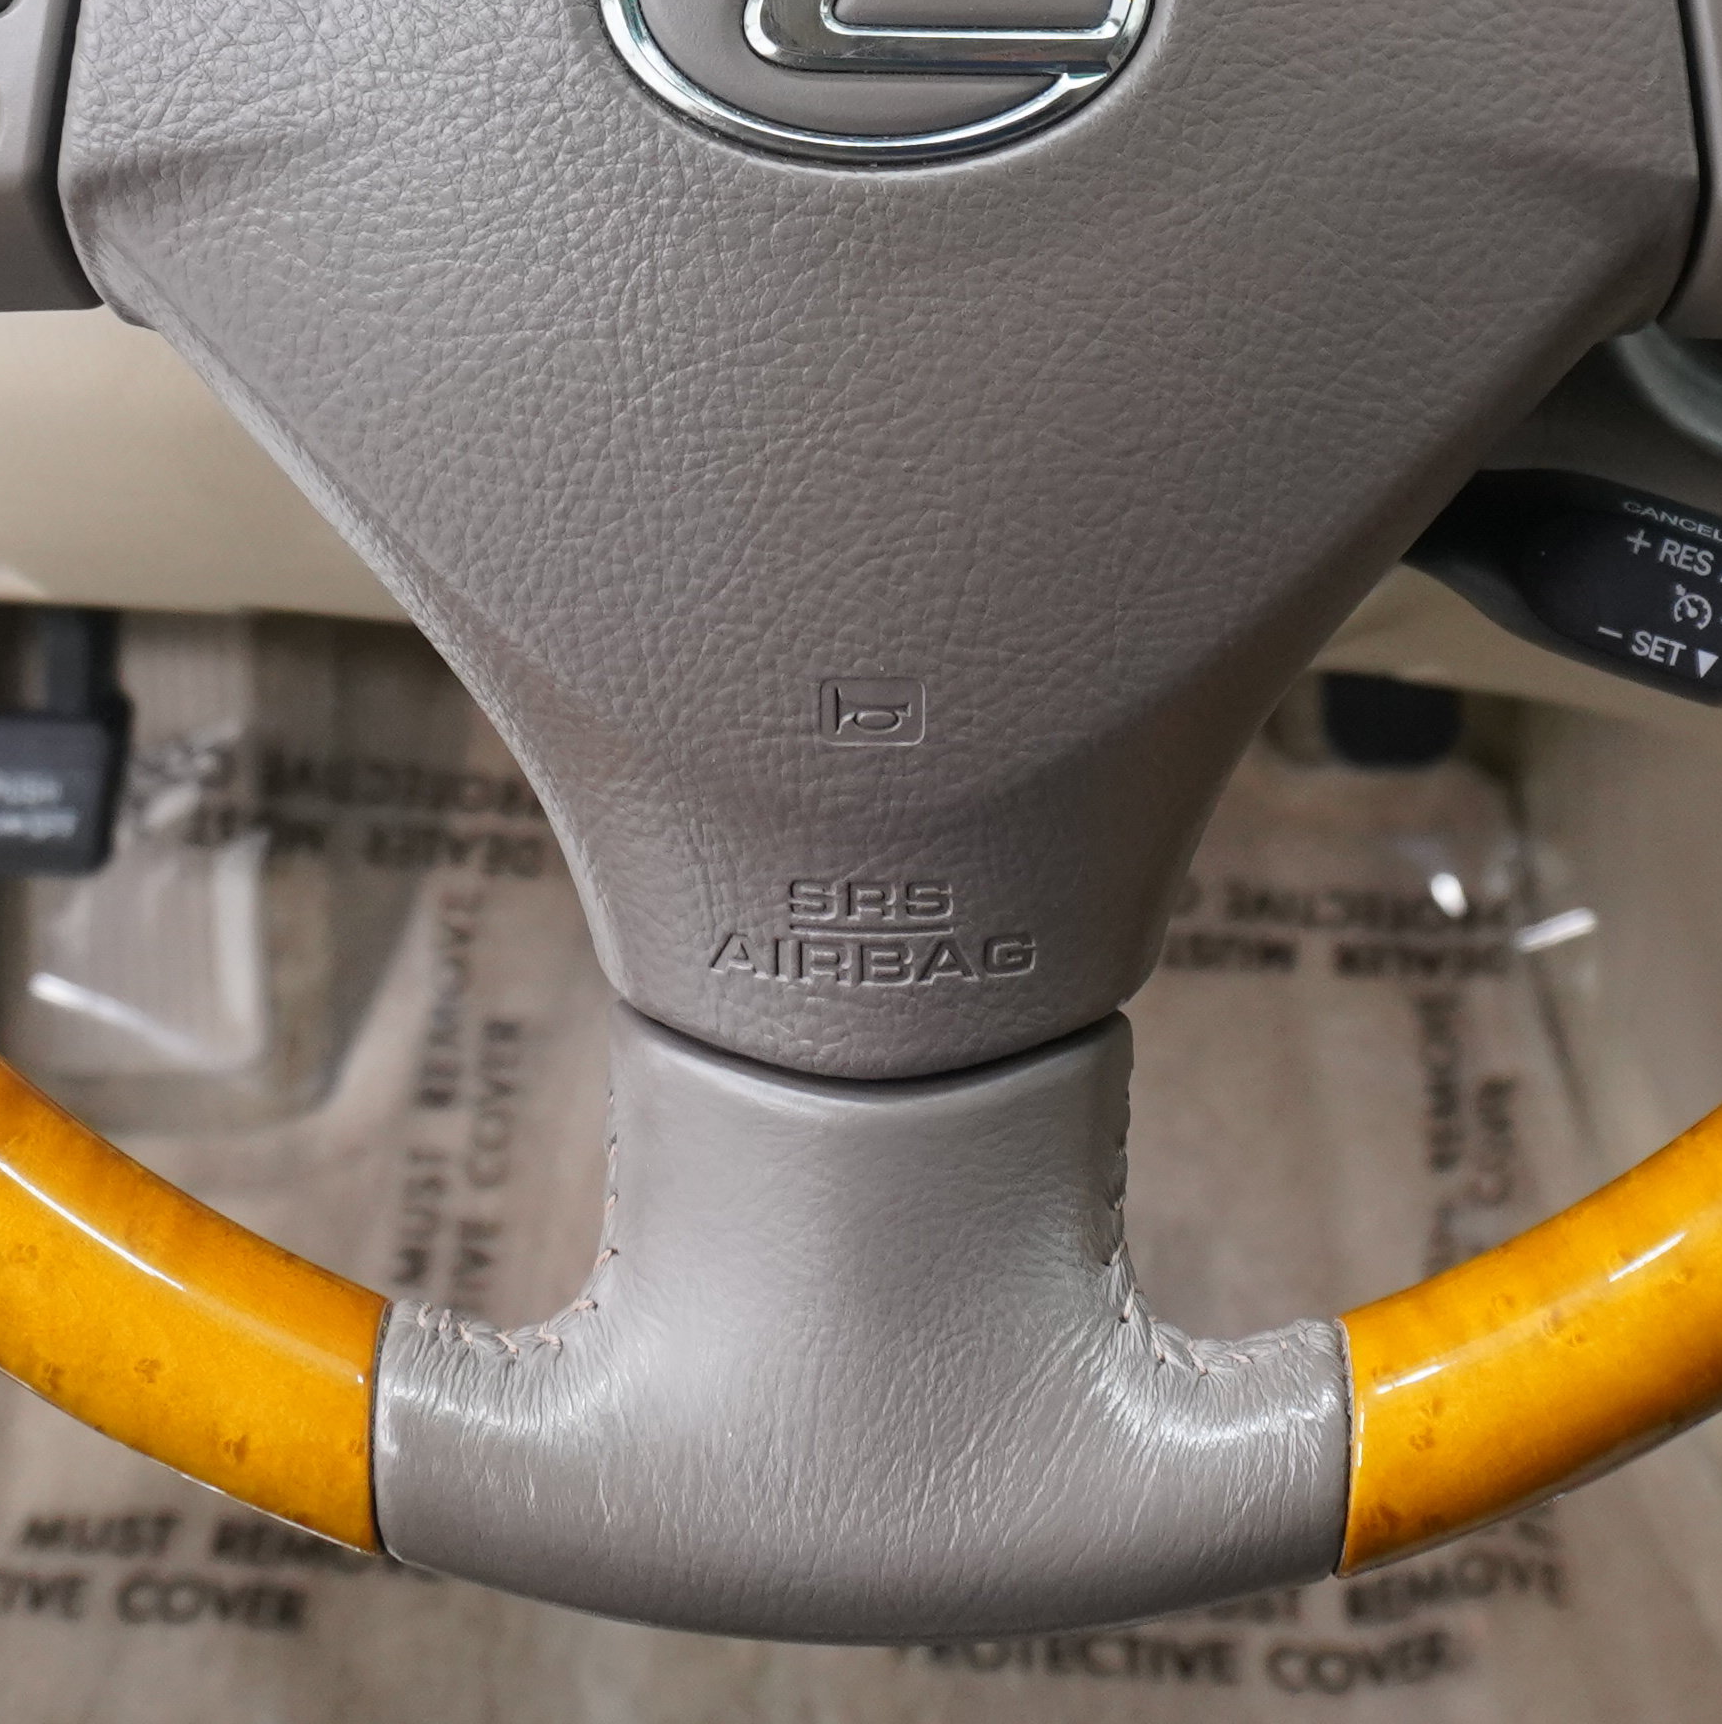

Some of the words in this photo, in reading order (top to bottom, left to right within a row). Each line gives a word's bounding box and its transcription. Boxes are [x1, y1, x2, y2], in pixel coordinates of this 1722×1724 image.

[1659, 538, 1715, 577] RES
[1631, 630, 1687, 667] SET
[788, 880, 954, 921] SRS
[710, 932, 1038, 987] AIRBAG
[115, 1573, 308, 1632] COVER
